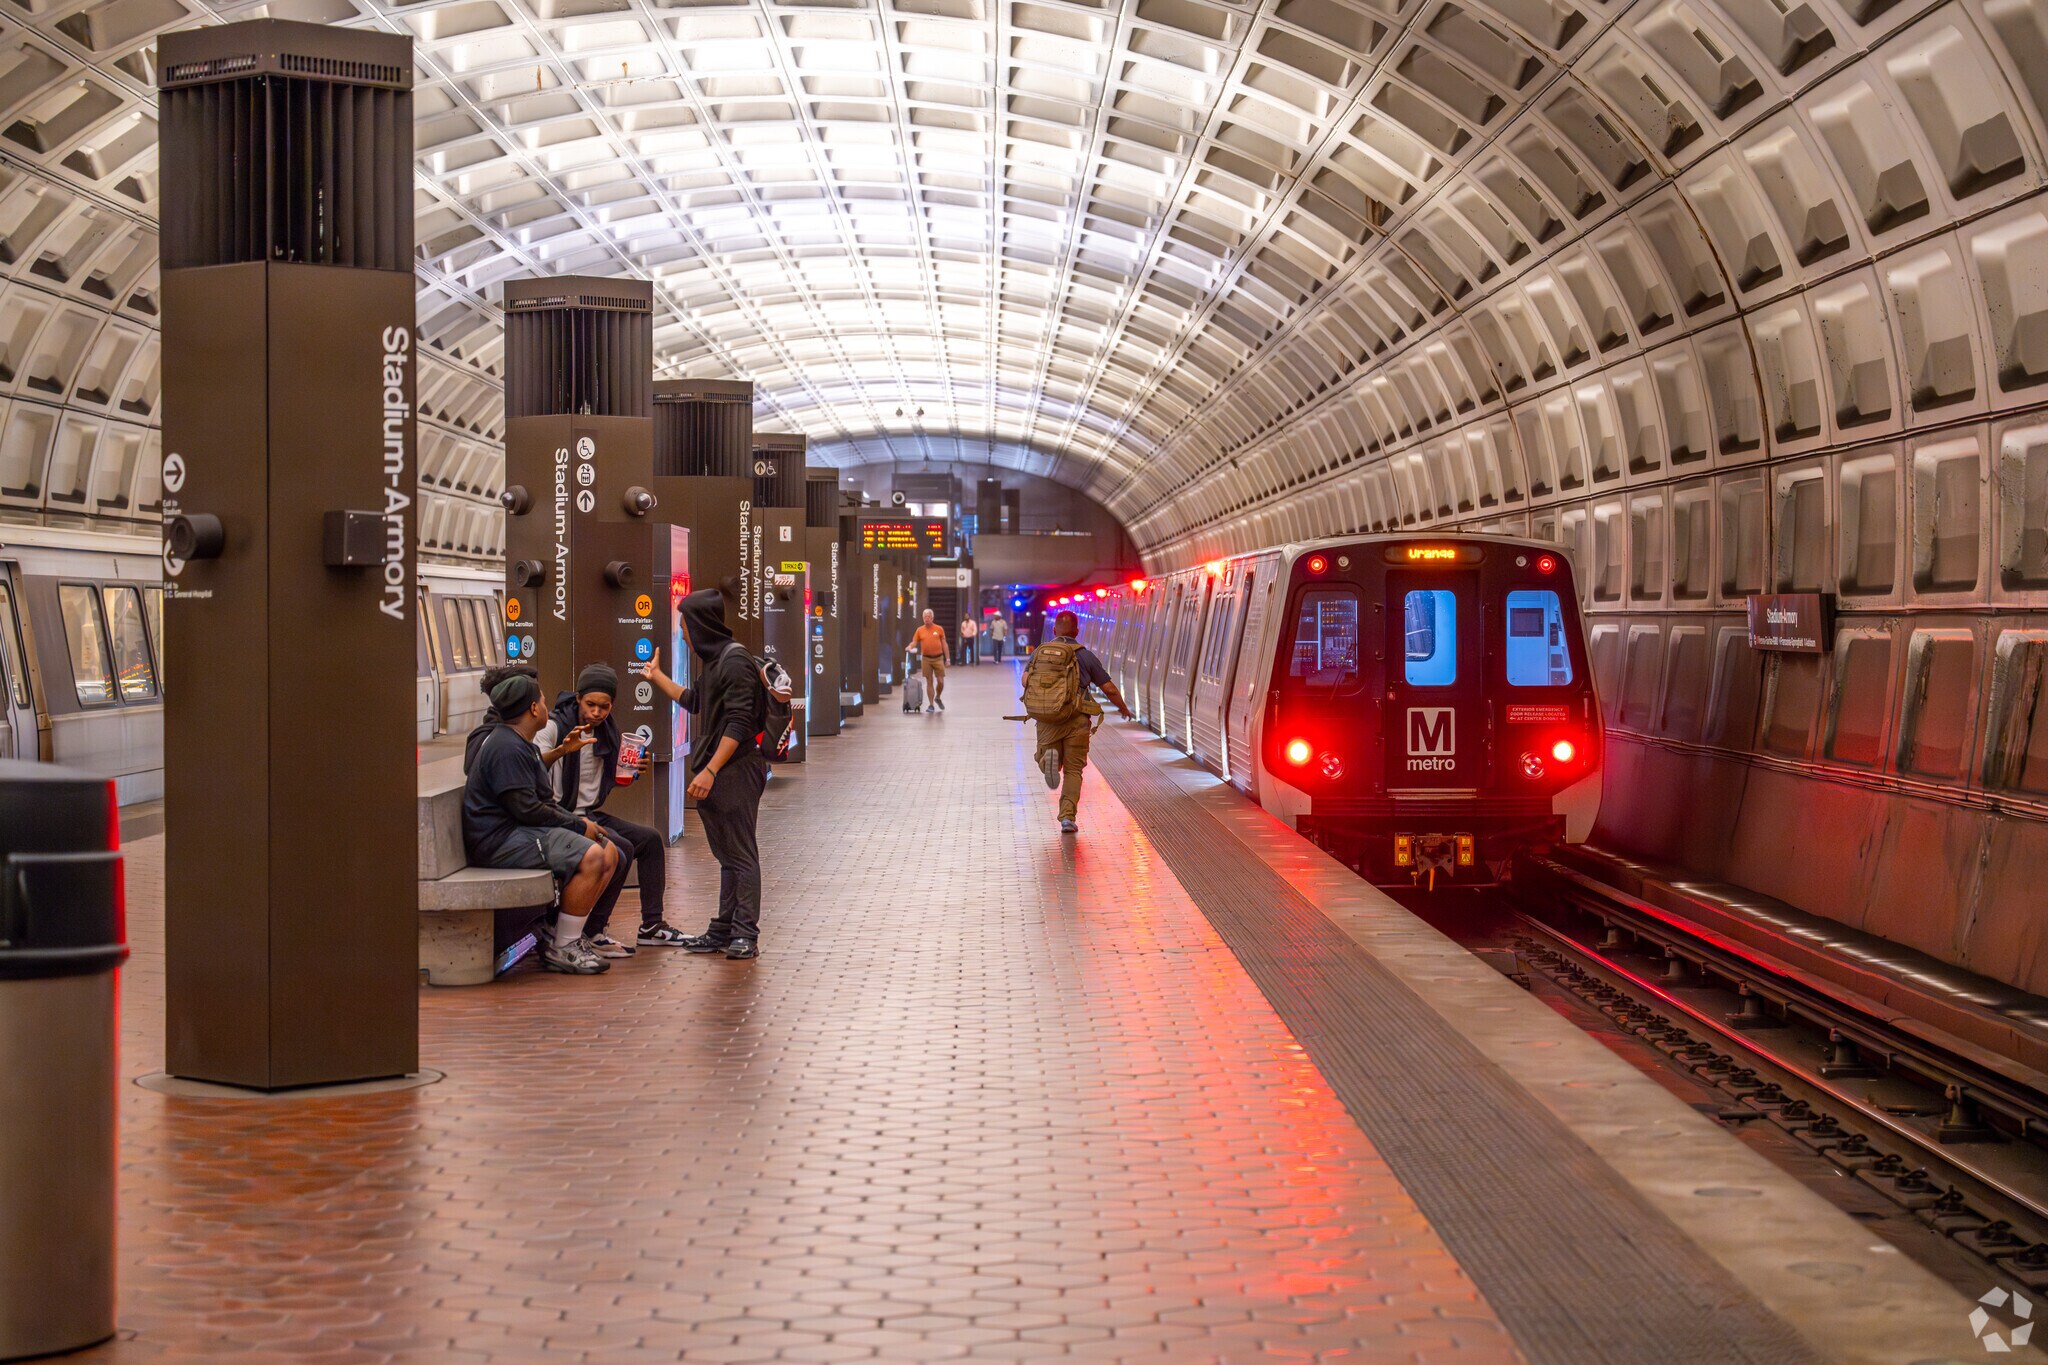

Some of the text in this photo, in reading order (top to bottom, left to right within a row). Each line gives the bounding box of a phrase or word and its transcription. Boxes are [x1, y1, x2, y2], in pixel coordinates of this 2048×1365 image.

[379, 325, 411, 620] Stadium-Armory
[553, 447, 569, 621] Stadium-Armory
[738, 500, 751, 621] Stadium-Armory
[752, 525, 763, 620] Stadium-Armory
[508, 604, 519, 614] OR
[637, 601, 650, 610] OR
[508, 641, 518, 651] BL
[523, 641, 533, 651] SV
[638, 644, 650, 654] BL
[637, 688, 650, 697] SV
[1411, 711, 1452, 752] M
[621, 755, 639, 765] GUL
[1407, 756, 1456, 771] metro
